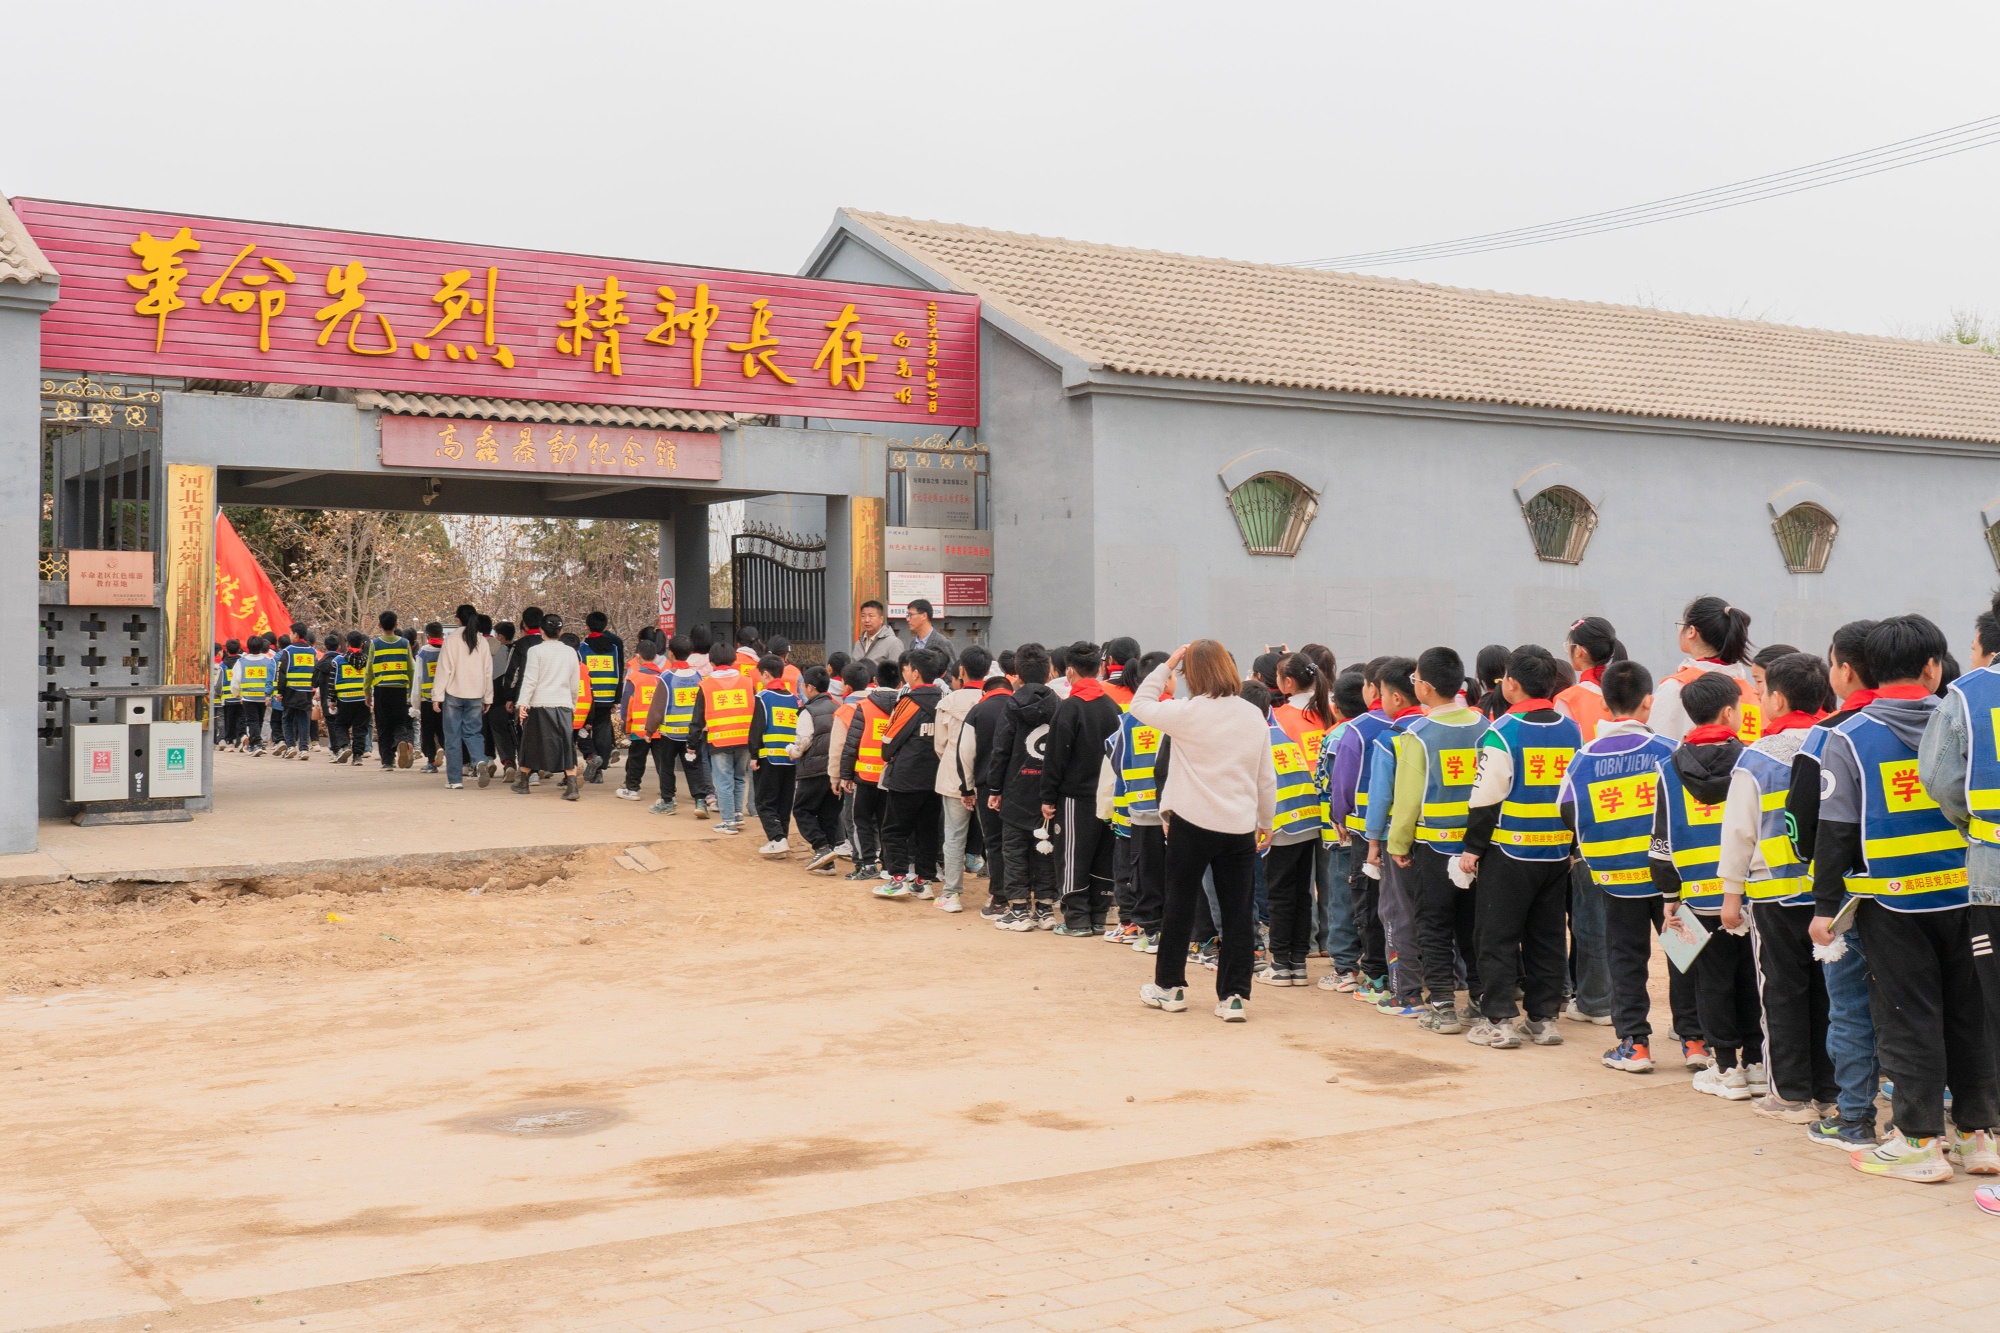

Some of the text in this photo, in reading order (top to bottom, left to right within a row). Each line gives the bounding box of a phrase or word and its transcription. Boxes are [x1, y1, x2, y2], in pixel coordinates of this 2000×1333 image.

[125, 226, 516, 370] 革命先烈
[80, 571, 144, 580] 革命老区红色旅游
[96, 580, 128, 588] 教育基地
[296, 655, 313, 664] 学生
[381, 662, 402, 670] 学生
[589, 658, 612, 669] 学生
[247, 669, 265, 677] 学生
[717, 693, 744, 706] 学生
[775, 710, 797, 725] 学生
[1137, 730, 1156, 750] 学
[1273, 748, 1306, 769] 学生
[1529, 754, 1570, 779] 学生
[1891, 768, 1922, 803] 学
[1598, 781, 1656, 814] 学生
